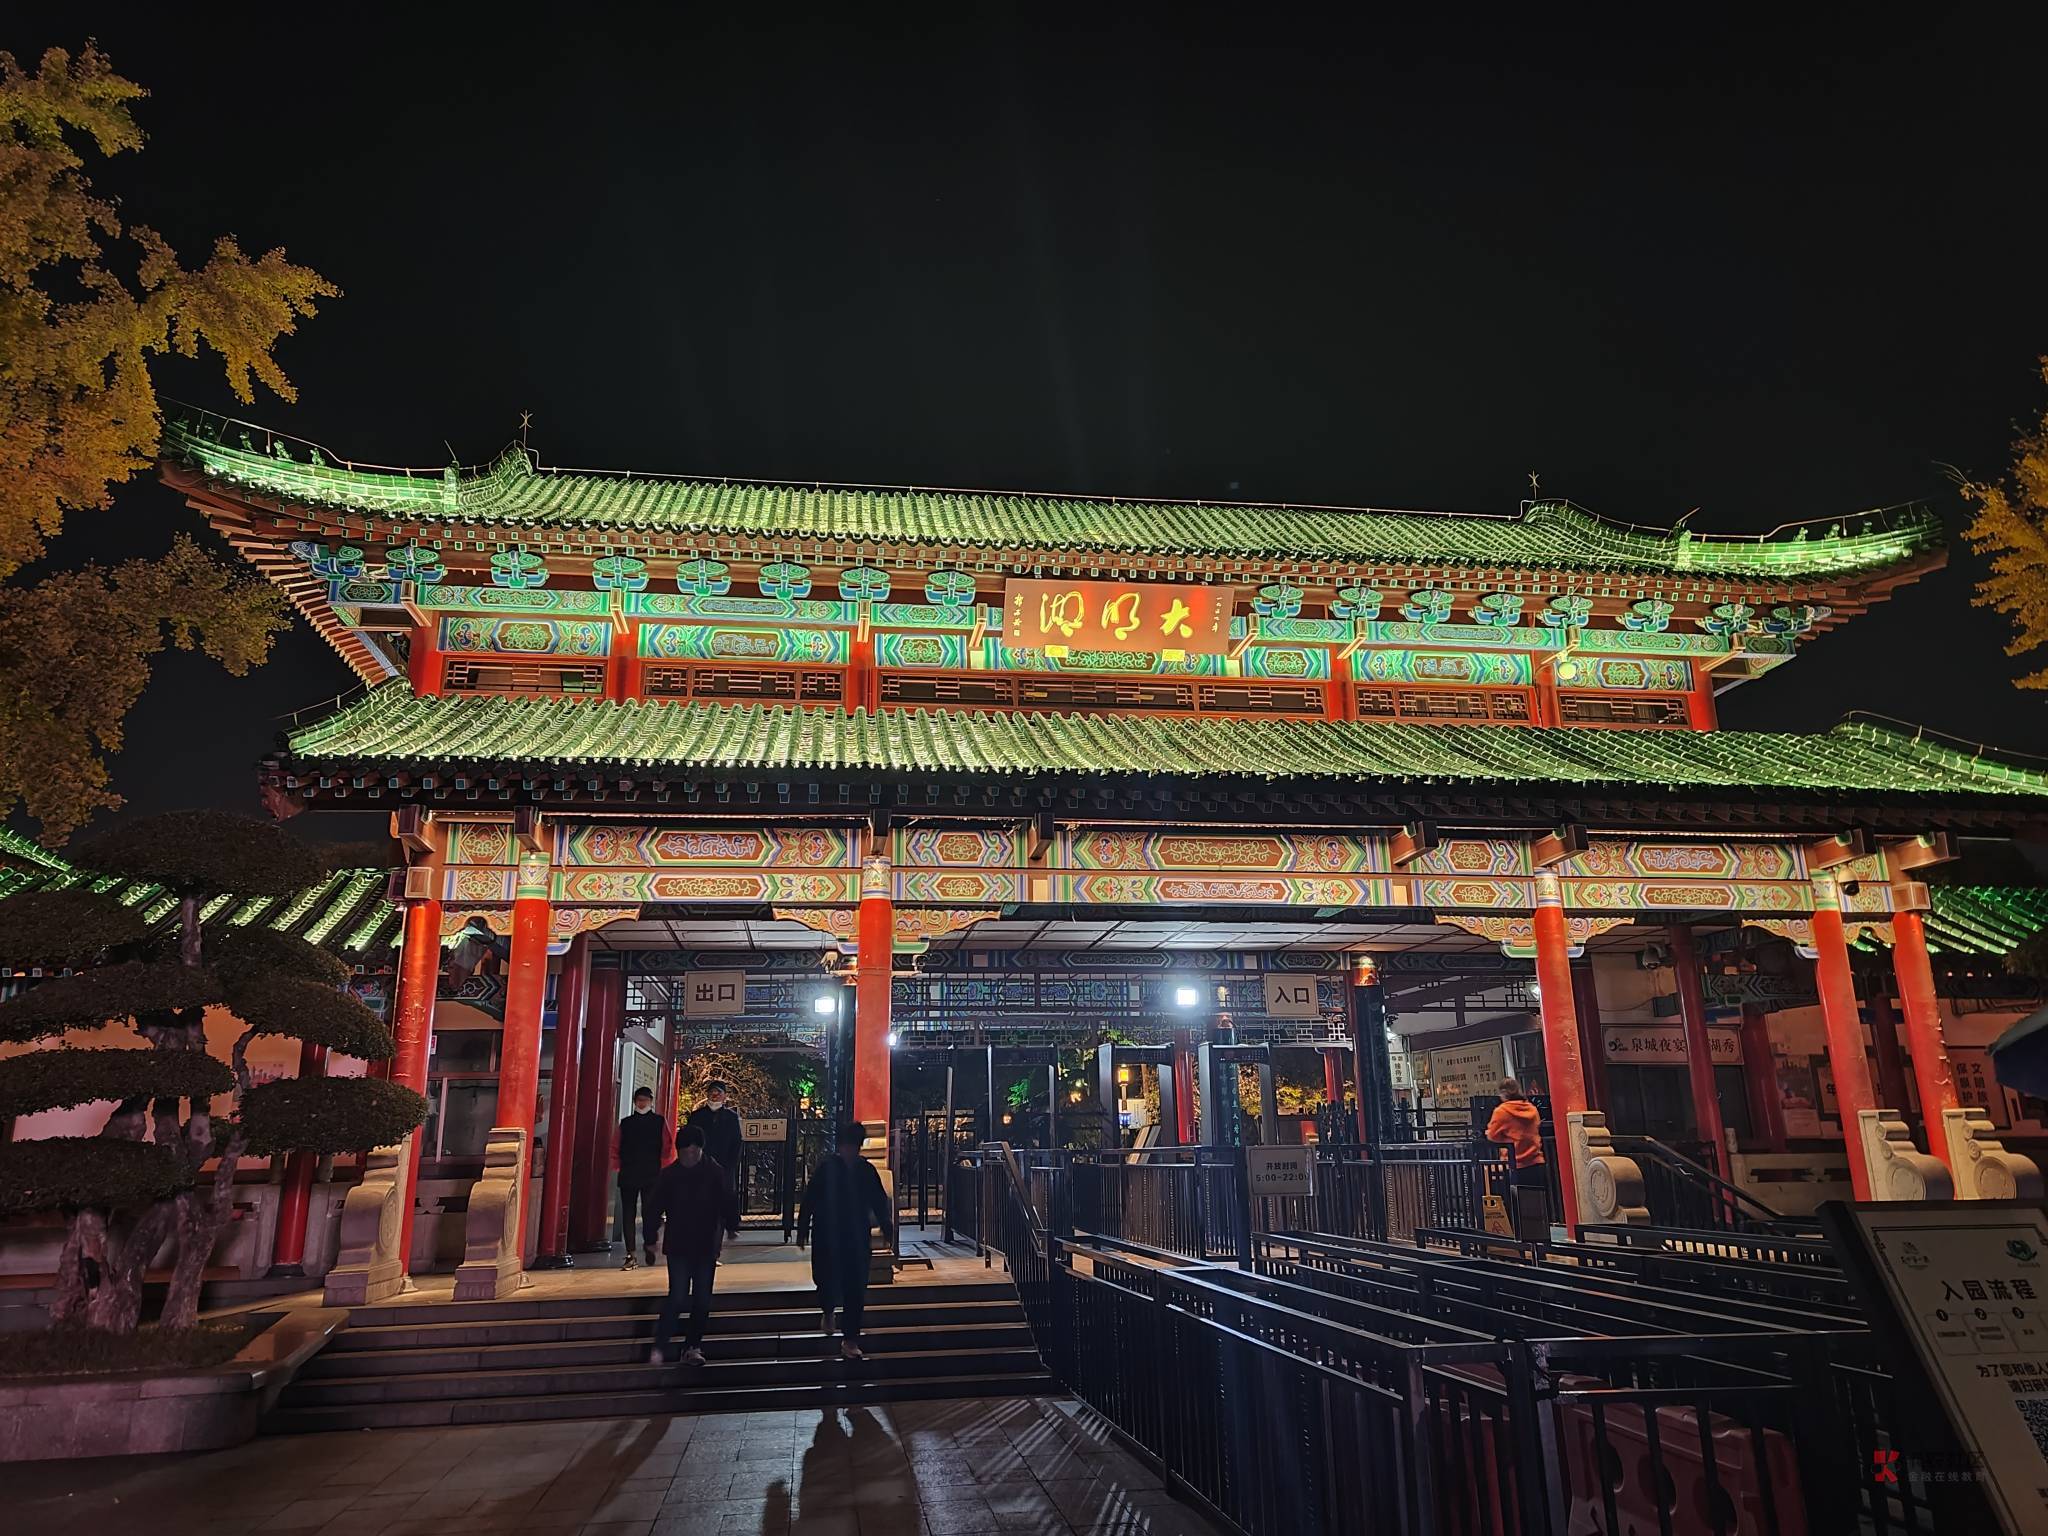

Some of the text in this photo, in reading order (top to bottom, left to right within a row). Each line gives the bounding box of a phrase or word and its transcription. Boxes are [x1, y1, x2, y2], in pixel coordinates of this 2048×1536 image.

[695, 982, 736, 1002] 出口
[1274, 986, 1310, 1004] 入口
[1265, 1161, 1298, 1171] 开放时间
[1941, 1279, 2038, 1302] 入园流程
